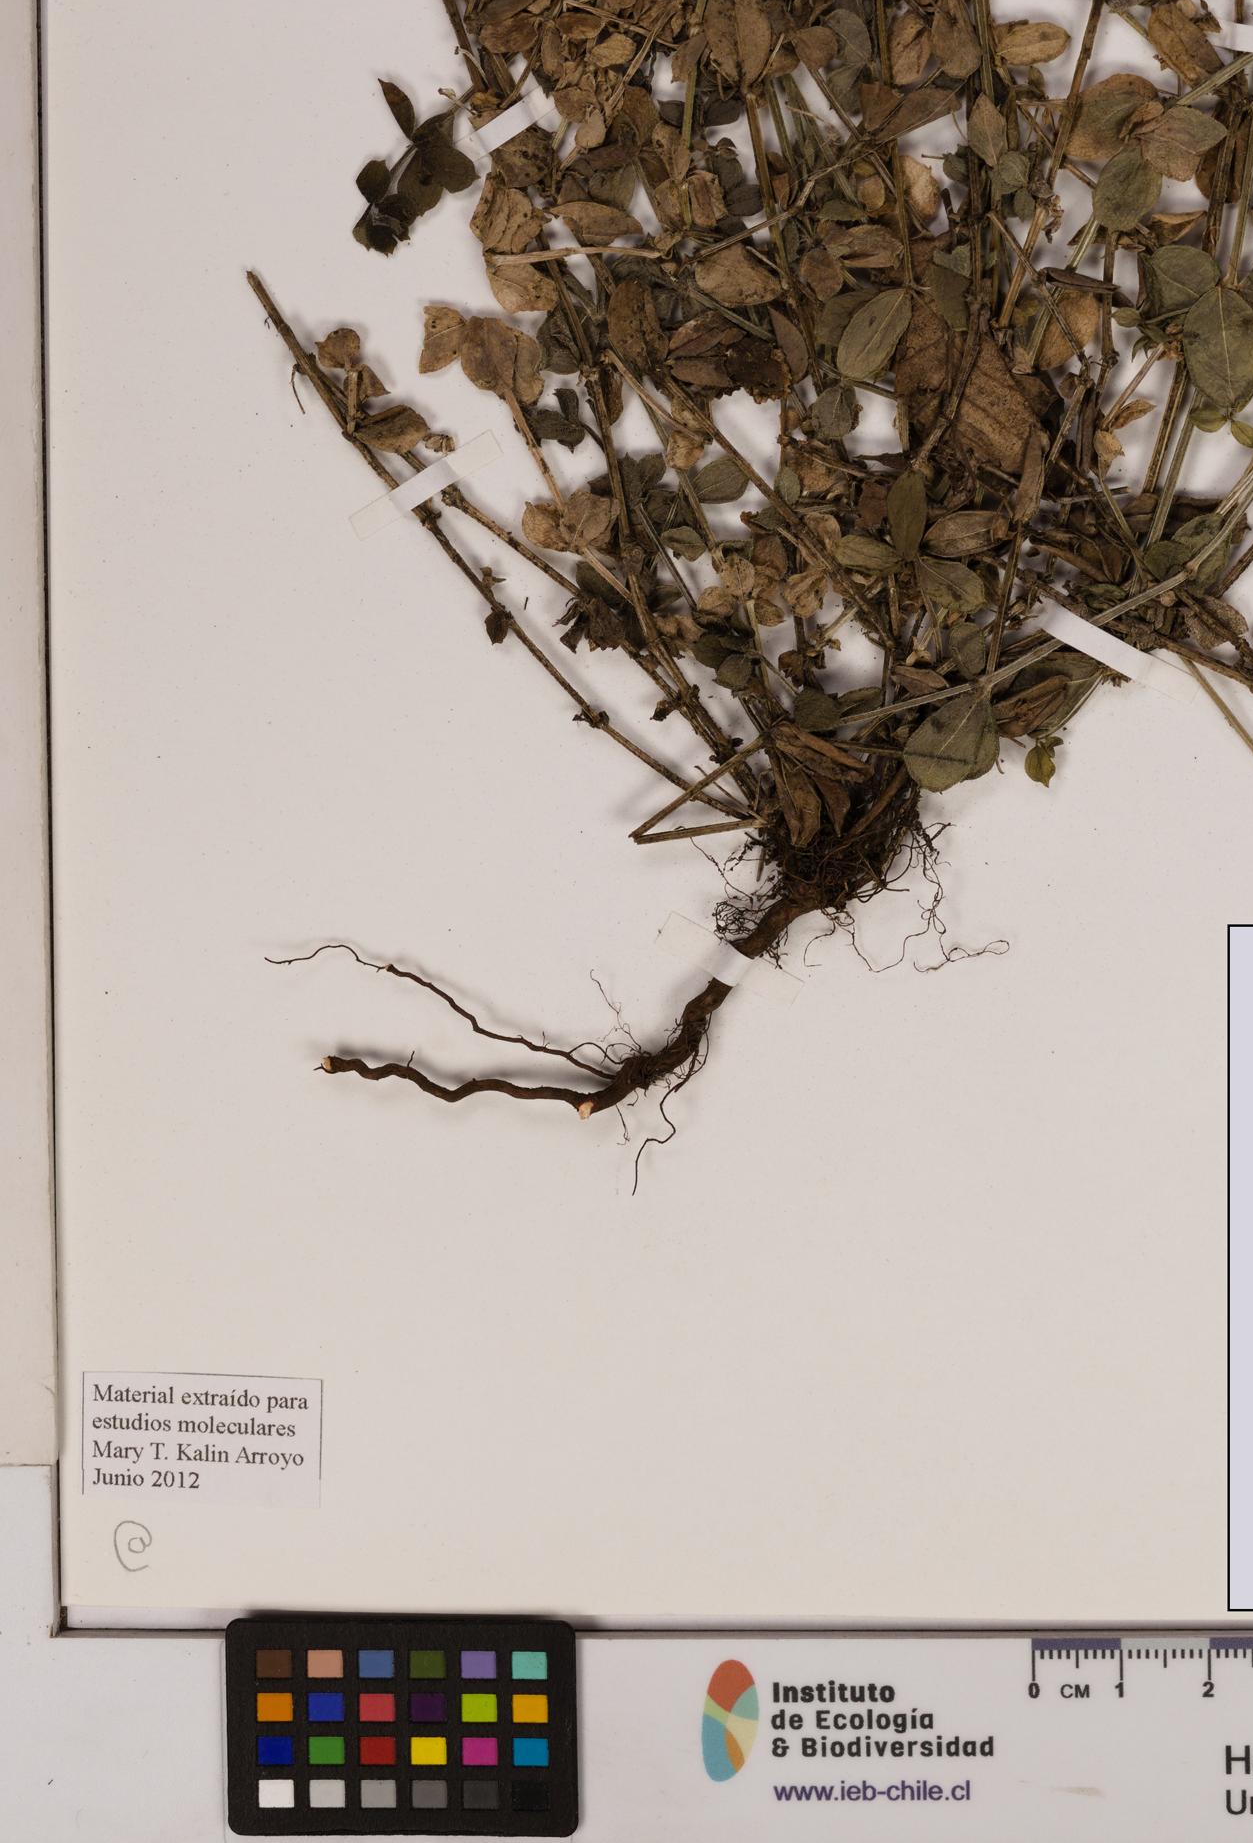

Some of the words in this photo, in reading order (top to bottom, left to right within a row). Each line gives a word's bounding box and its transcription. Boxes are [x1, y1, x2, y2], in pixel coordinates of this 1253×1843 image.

[93, 1384, 174, 1405] Material
[181, 1389, 260, 1408] extraído
[266, 1395, 309, 1413] para
[92, 1413, 172, 1432] estudios
[177, 1416, 296, 1438] moleculares
[92, 1440, 144, 1464] Mary
[150, 1442, 169, 1461] T.
[176, 1443, 229, 1464] Kalin
[235, 1446, 305, 1471] Arroyo
[92, 1468, 145, 1488] Junio
[150, 1470, 200, 1489] 2012
[772, 1680, 896, 1704] Instituto
[1027, 1681, 1041, 1700] 0
[1060, 1683, 1091, 1699] CM
[1115, 1680, 1126, 1699] 1
[1202, 1679, 1216, 1699] 2
[771, 1709, 805, 1730] de
[815, 1707, 935, 1733] Ecología
[800, 1733, 996, 1758] Biodiversidad
[773, 1779, 971, 1802] www.ieb-chile.cl
